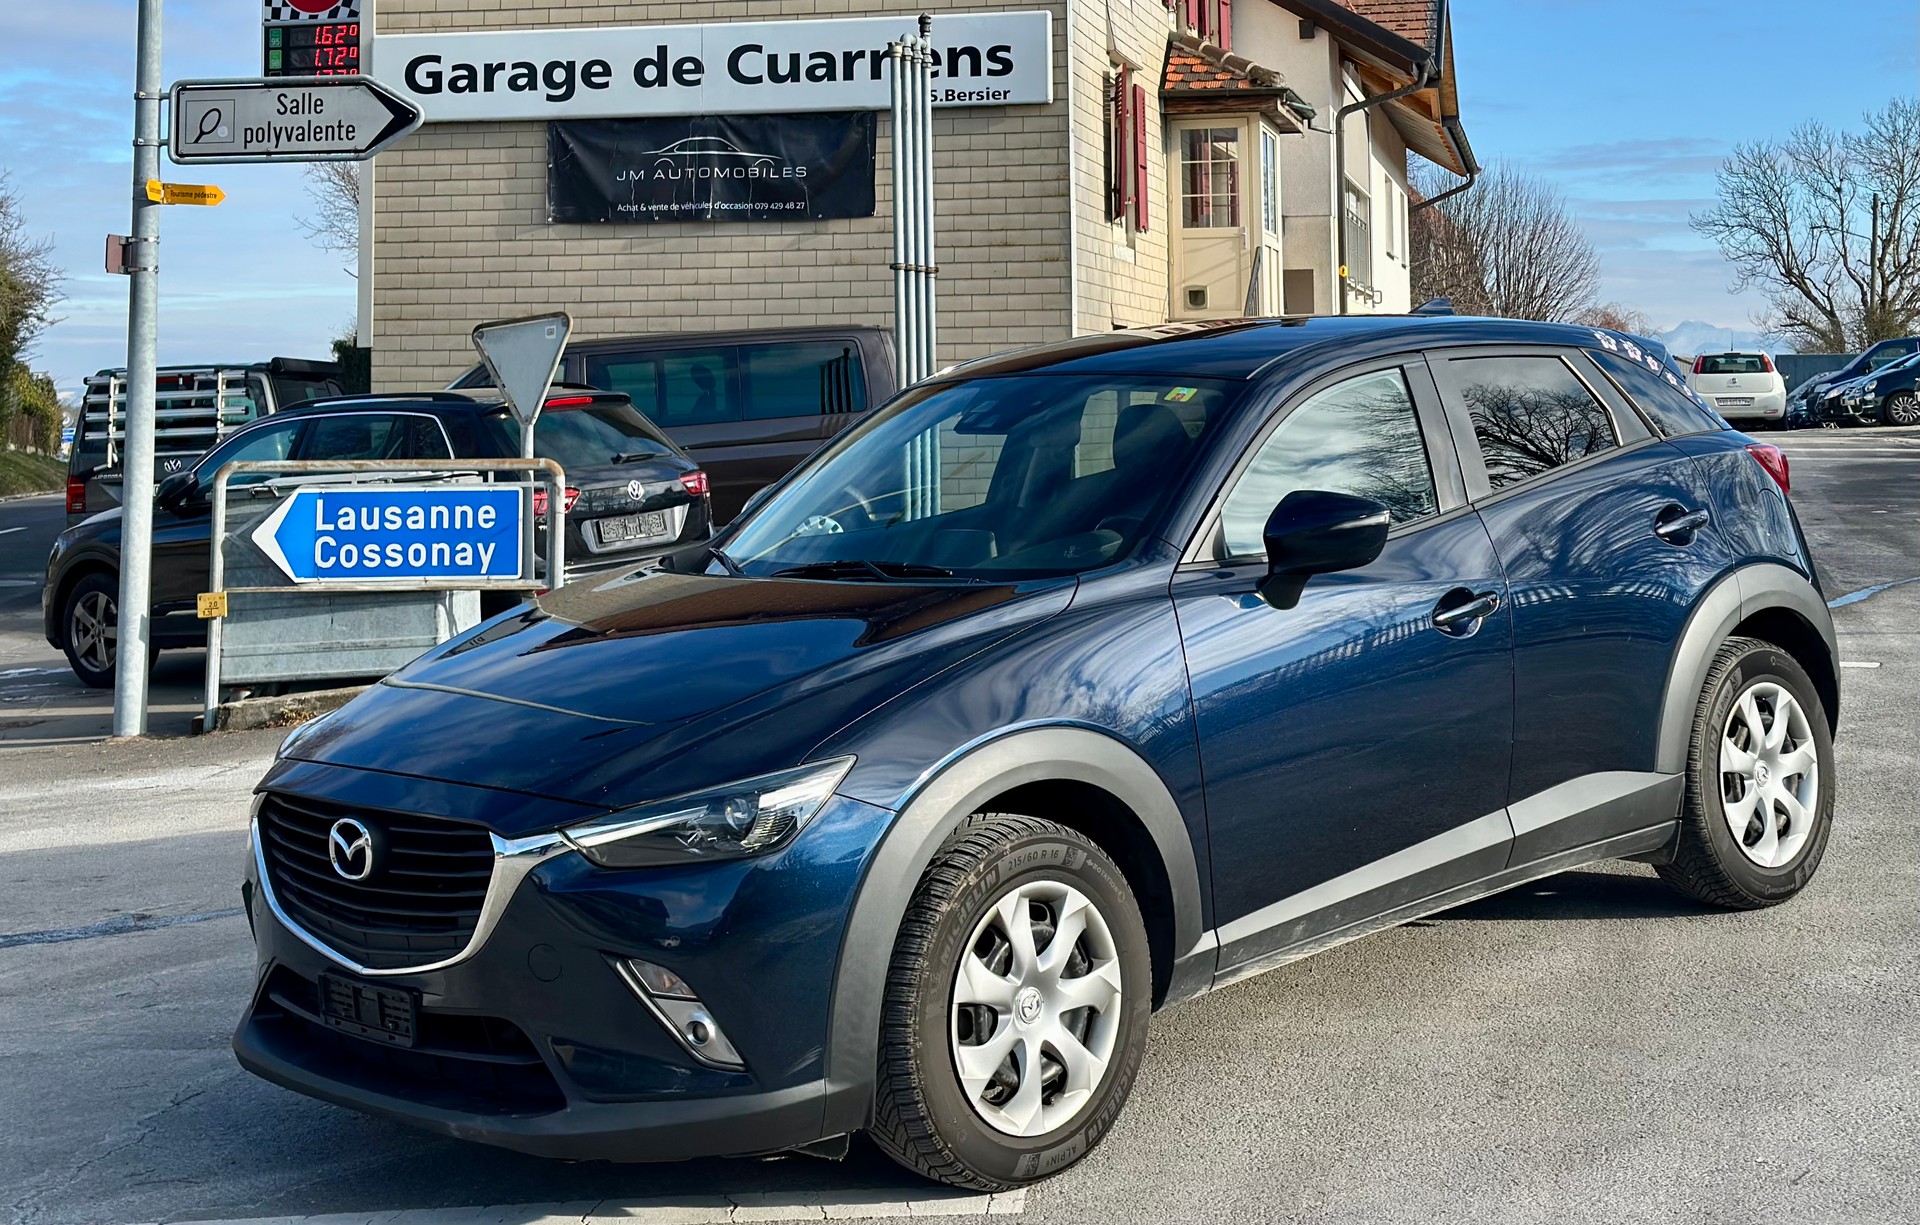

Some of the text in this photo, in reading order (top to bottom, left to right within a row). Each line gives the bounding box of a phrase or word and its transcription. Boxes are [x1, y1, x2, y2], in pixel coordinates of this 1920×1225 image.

[404, 54, 613, 103] Garage
[632, 45, 705, 88] de
[276, 92, 324, 115] Salle
[930, 87, 1011, 102] S.Bersier
[243, 119, 356, 149] polyvalente
[616, 166, 807, 181] JM AUTOMOBILES
[170, 189, 193, 198] Tourisme
[194, 191, 218, 200] pédestre
[617, 203, 639, 212] Achat
[640, 203, 647, 211] &
[648, 203, 669, 211] vente
[670, 202, 680, 211] de
[714, 201, 753, 210] d'occasion
[754, 202, 769, 210] 079
[770, 202, 783, 210] 429
[785, 202, 795, 210] 48
[796, 202, 805, 210] 27
[316, 499, 497, 531] Lausanne
[314, 535, 497, 575] Cossonay
[1008, 849, 1060, 871] 215/60 R 16
[940, 869, 998, 966] MICHELIN
